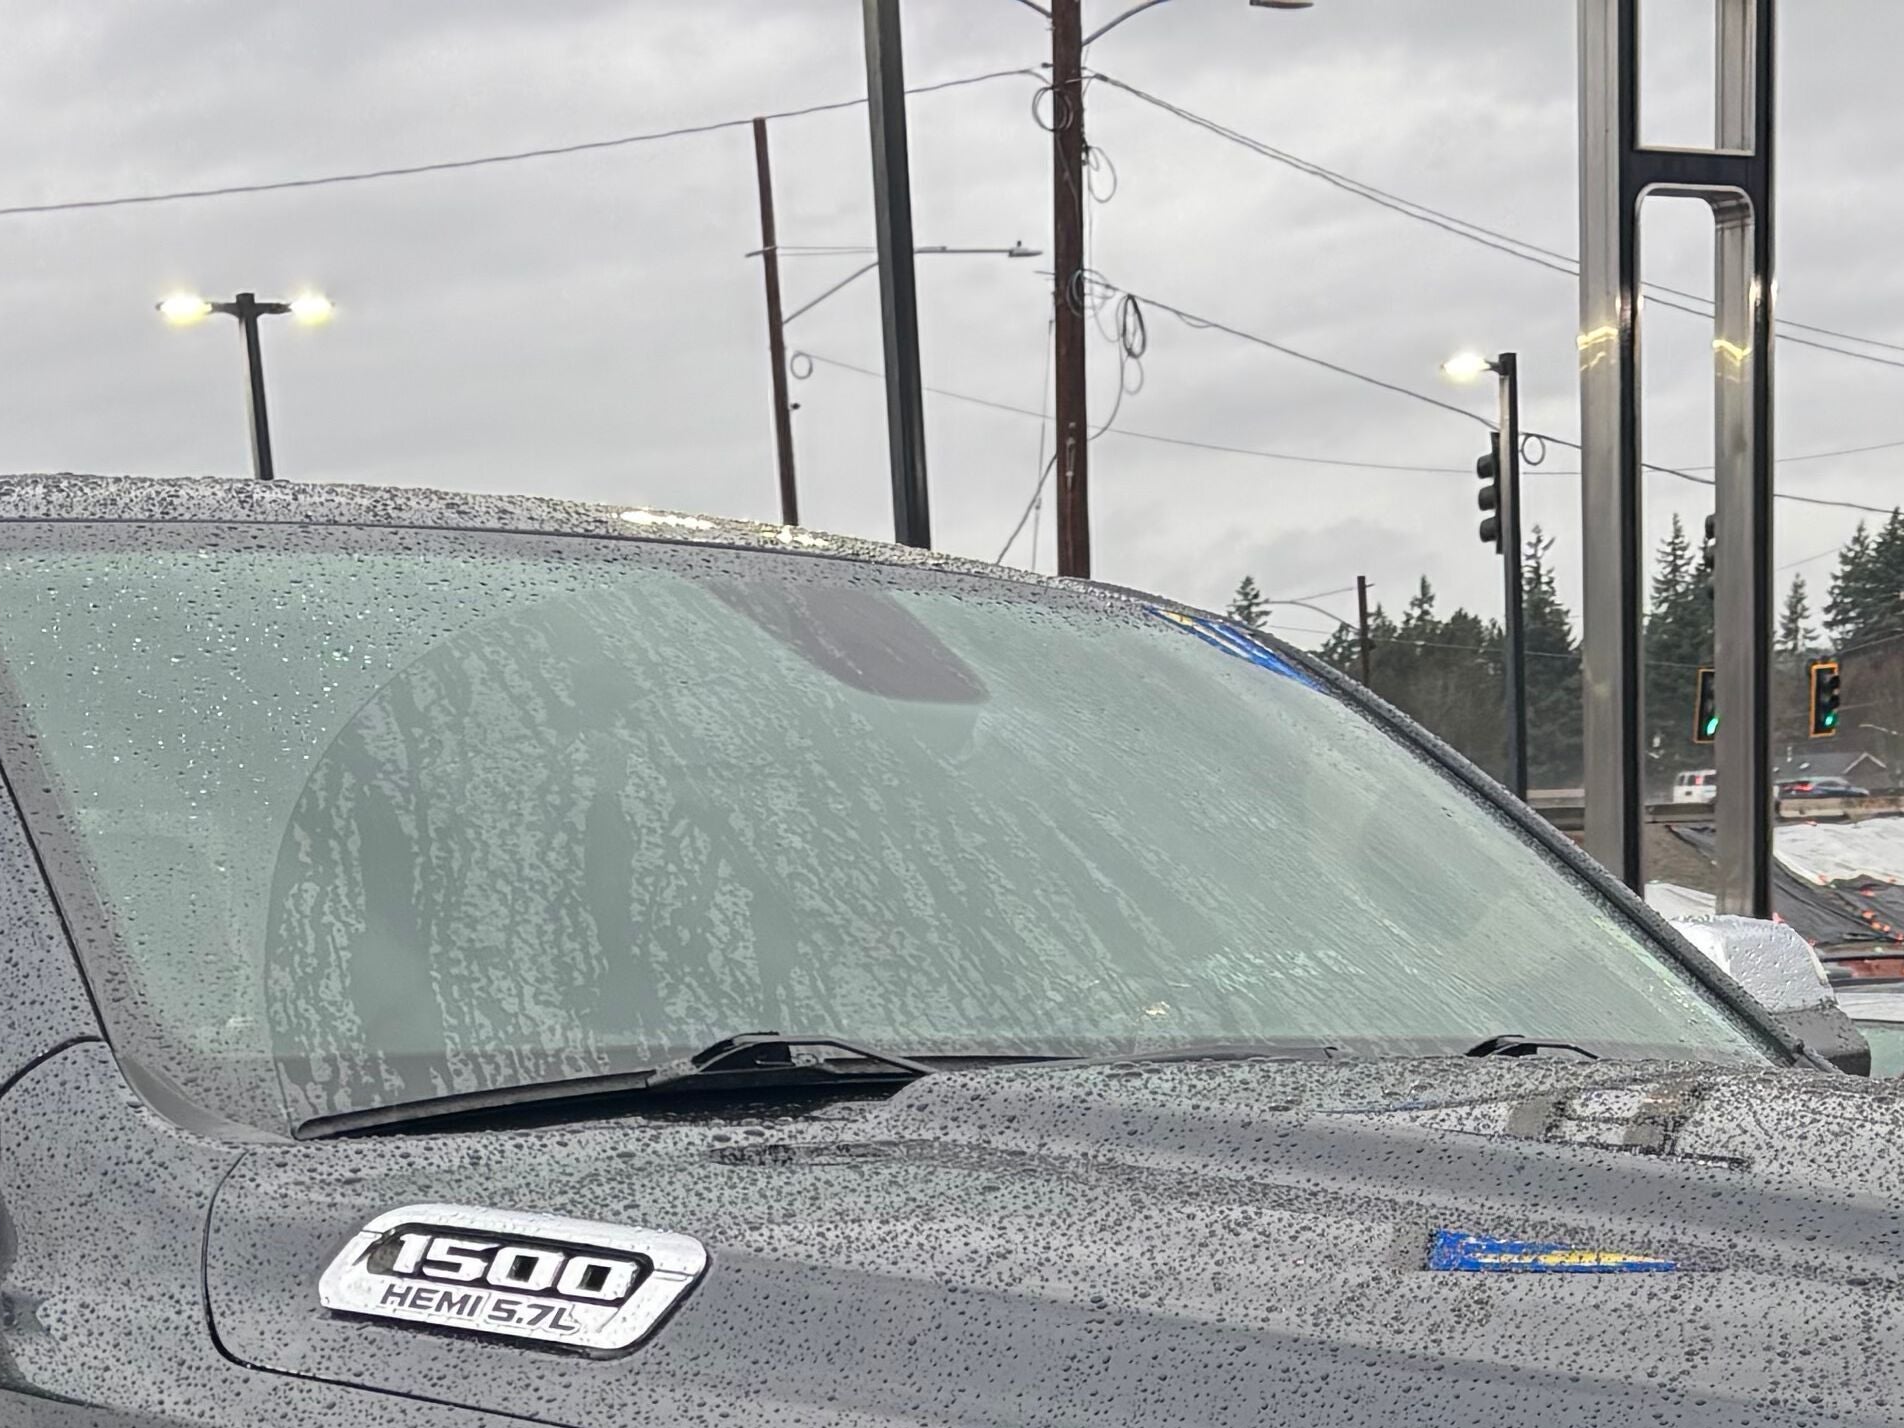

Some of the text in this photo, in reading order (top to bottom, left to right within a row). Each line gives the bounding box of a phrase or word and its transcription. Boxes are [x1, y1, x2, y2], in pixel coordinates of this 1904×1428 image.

[392, 1233, 640, 1301] 1500
[380, 1284, 578, 1332] HEMI 5.7L
